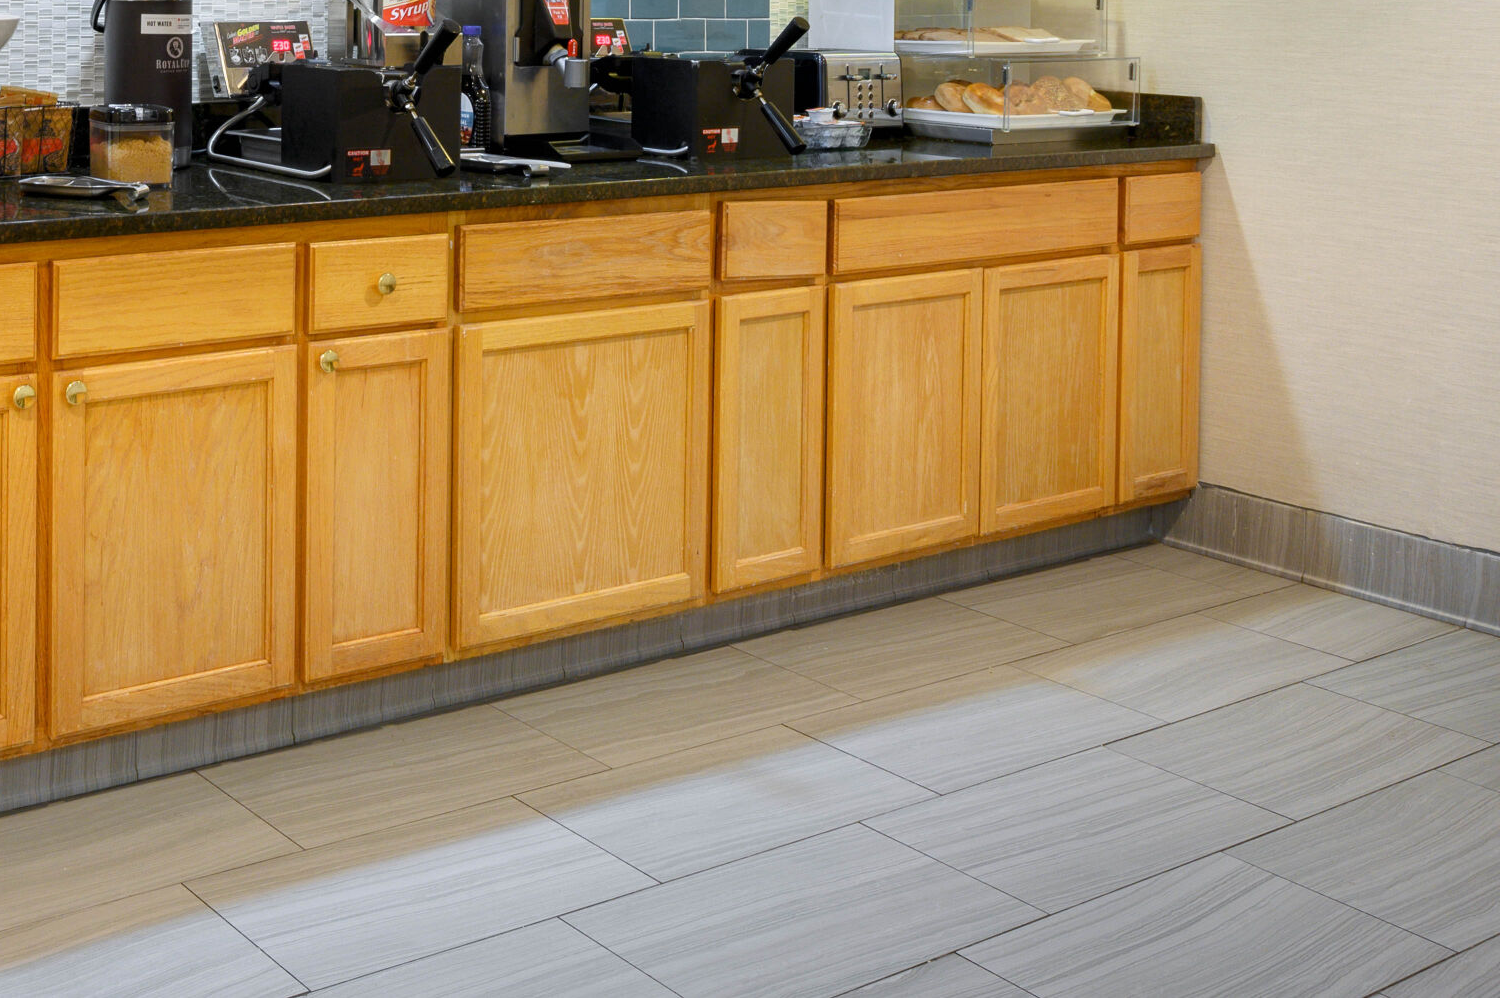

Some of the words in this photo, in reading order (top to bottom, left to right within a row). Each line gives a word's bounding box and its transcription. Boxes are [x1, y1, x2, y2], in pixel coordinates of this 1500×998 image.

[390, 1, 429, 21] Syrup
[236, 23, 260, 37] GOLDEN
[273, 40, 291, 51] 230
[596, 35, 610, 45] 230
